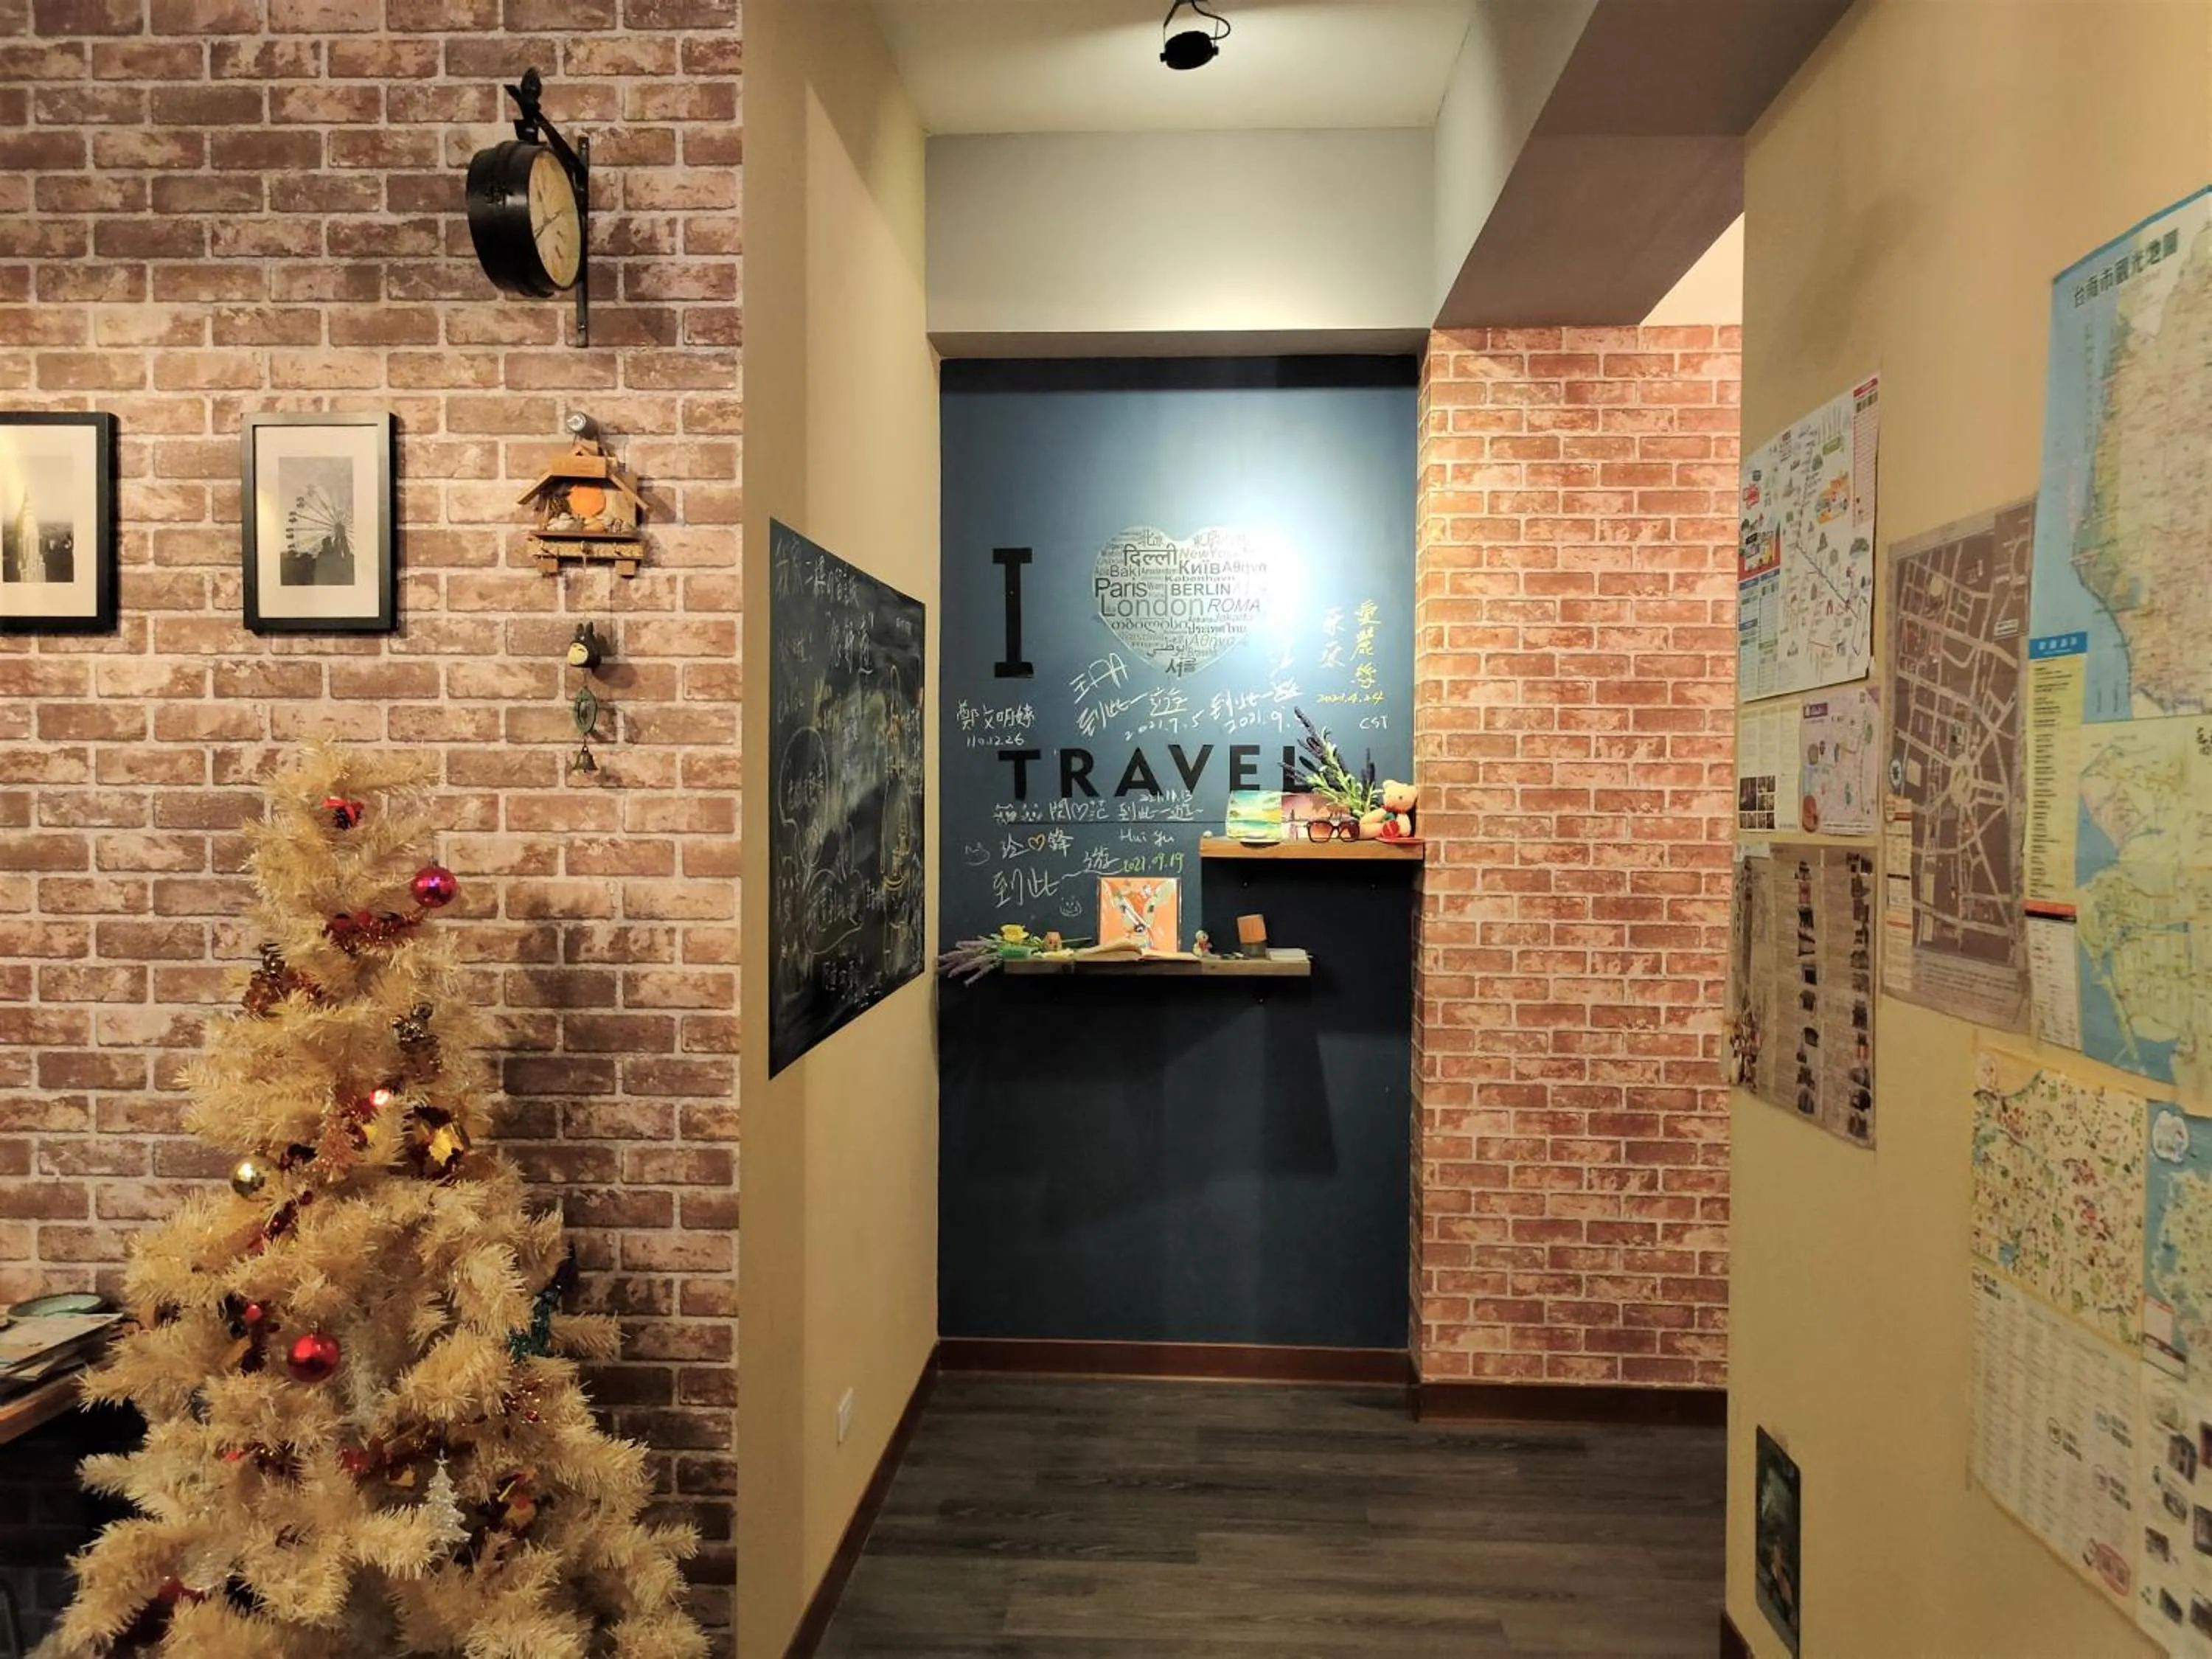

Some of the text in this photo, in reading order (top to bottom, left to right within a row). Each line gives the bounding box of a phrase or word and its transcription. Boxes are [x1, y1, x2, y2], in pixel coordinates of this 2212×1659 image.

[1122, 543, 1178, 566] दिल्ली
[1180, 559, 1221, 575] Київ
[1095, 577, 1148, 598] Paris
[1171, 583, 1231, 597] BERLIN
[992, 547, 1034, 678] I
[1102, 593, 1204, 617] London
[1207, 598, 1261, 613] ROMA
[998, 744, 1318, 801] TRAVEL
